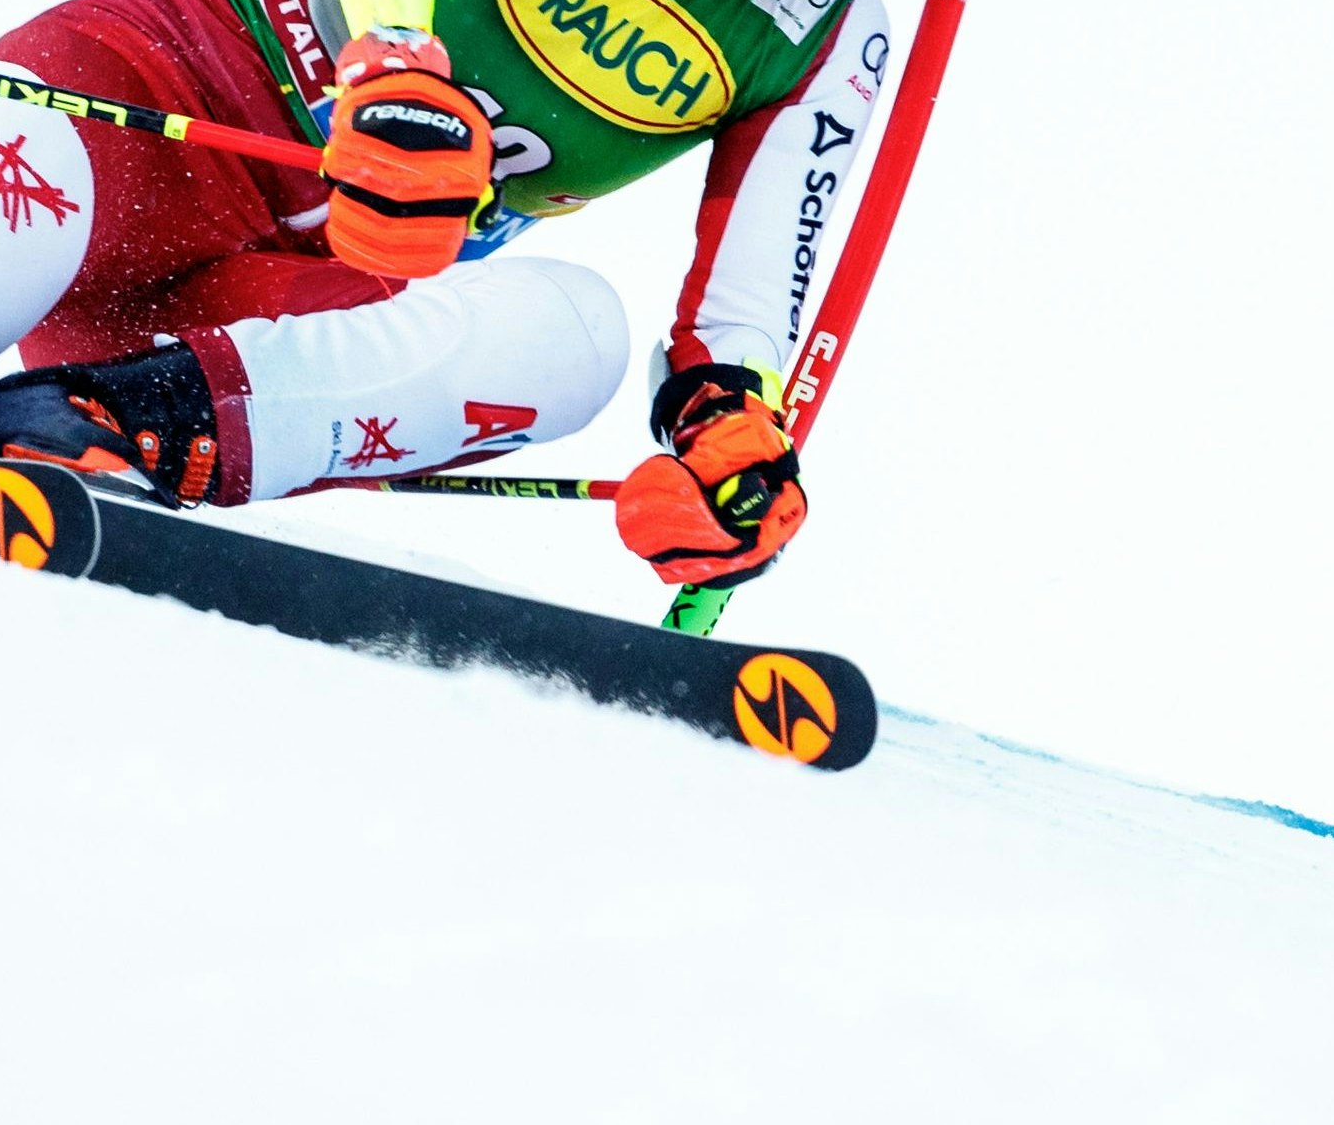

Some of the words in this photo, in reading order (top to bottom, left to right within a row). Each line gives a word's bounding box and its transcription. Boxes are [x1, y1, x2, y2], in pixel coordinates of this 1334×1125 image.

[0, 81, 128, 127] LEKI
[361, 101, 468, 137] reusch
[783, 329, 839, 443] ALPI
[731, 493, 765, 517] LEKI
